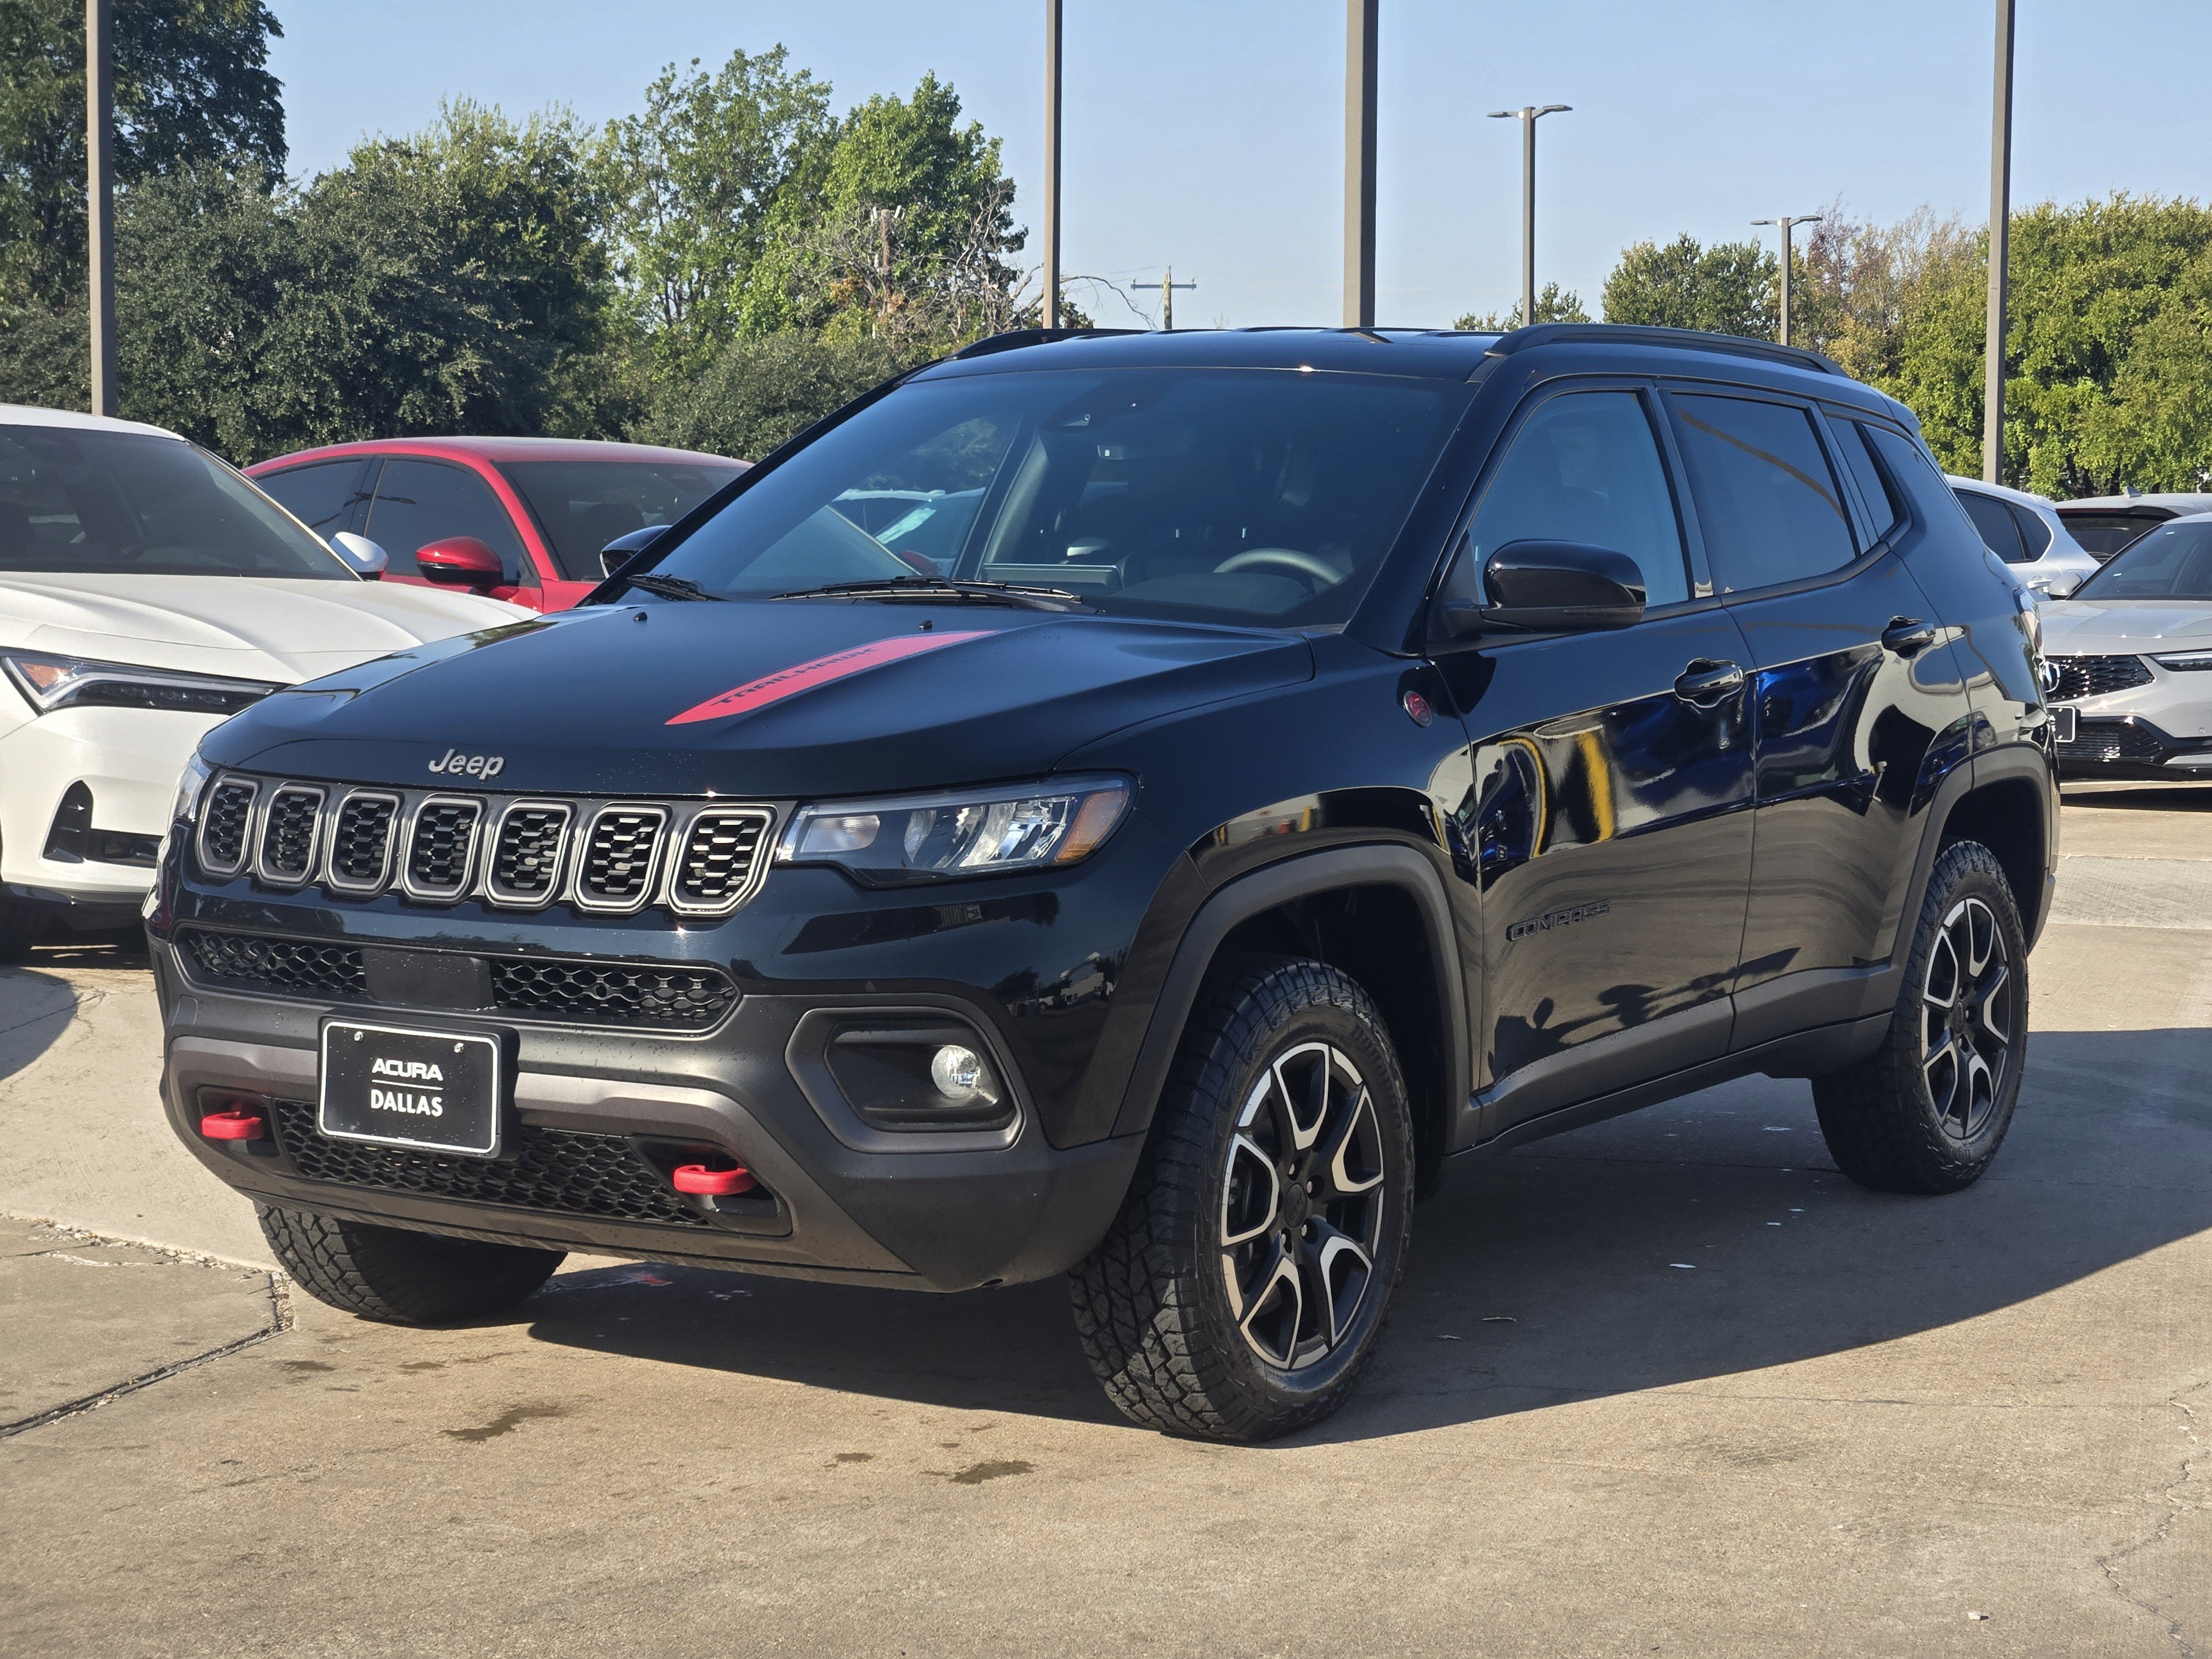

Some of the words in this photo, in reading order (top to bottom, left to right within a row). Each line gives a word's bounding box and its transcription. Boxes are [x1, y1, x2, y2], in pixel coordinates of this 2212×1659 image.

[709, 648, 877, 707] TRAILHAWK
[428, 748, 505, 781] Jeep
[1507, 899, 1610, 941] COMPASS
[371, 1058, 444, 1081] ACURA
[370, 1089, 443, 1117] DALLAS
